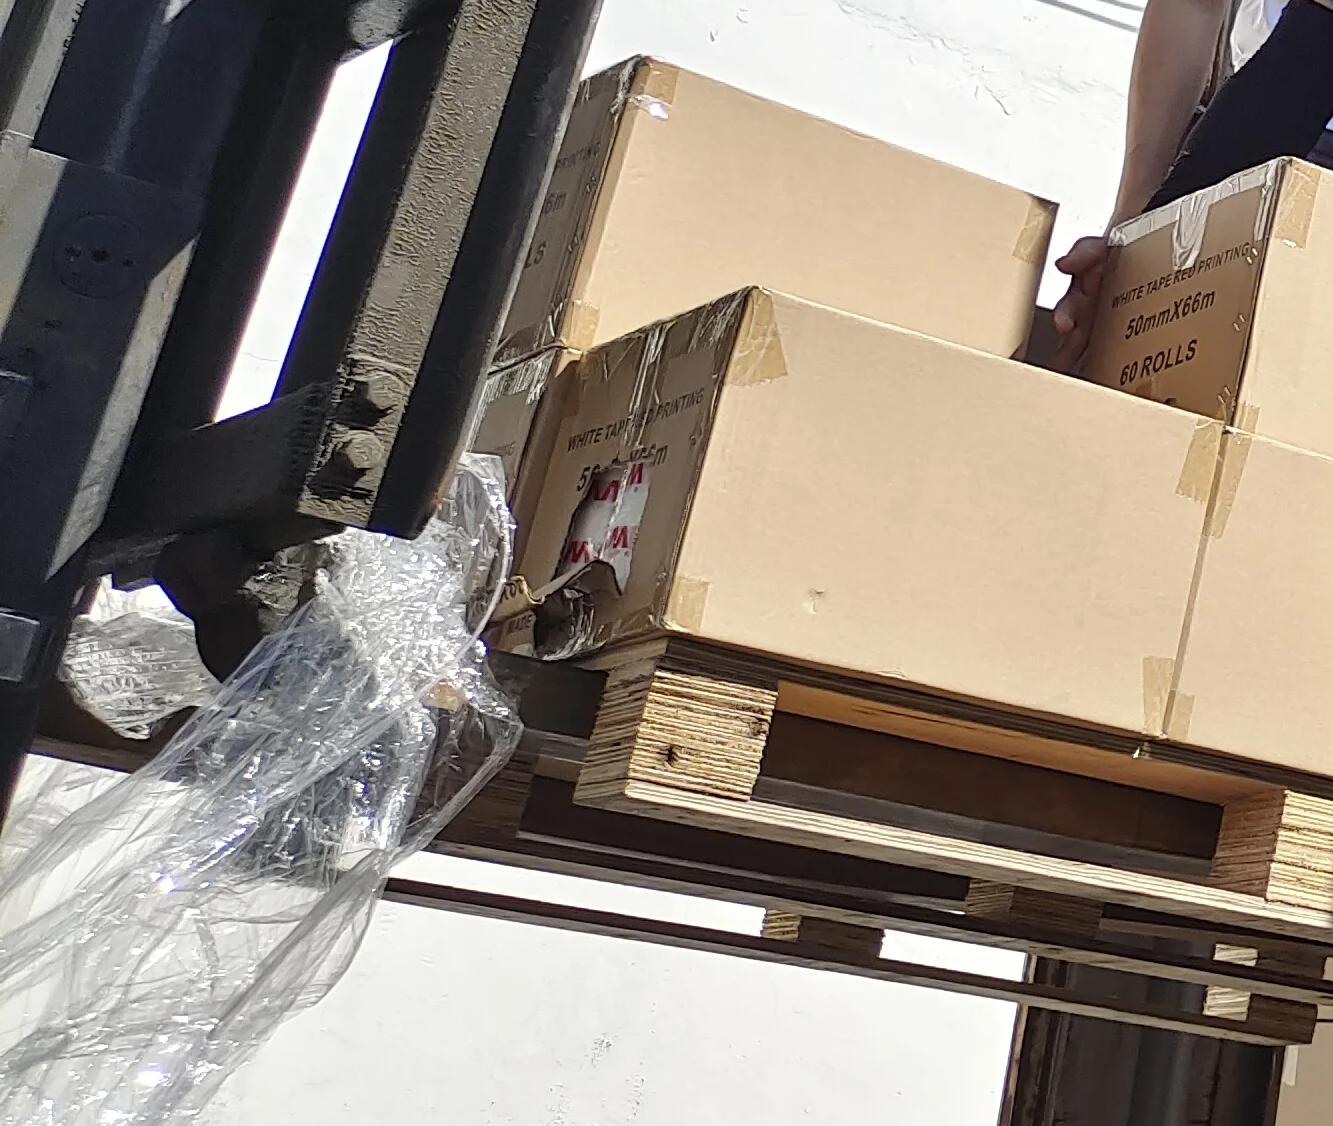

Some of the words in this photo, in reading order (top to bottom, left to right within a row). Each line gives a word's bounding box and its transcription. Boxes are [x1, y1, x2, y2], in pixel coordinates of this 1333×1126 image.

[1111, 284, 1144, 310] WHITE
[1145, 274, 1173, 294] TAPE
[1172, 265, 1196, 285] RED
[1197, 241, 1252, 273] PRINTING
[1125, 290, 1216, 341] 50mmX66m
[1119, 360, 1139, 386] 60
[1140, 338, 1198, 378] ROLLS
[567, 427, 604, 452] WHITE
[654, 388, 705, 424] PRINTING
